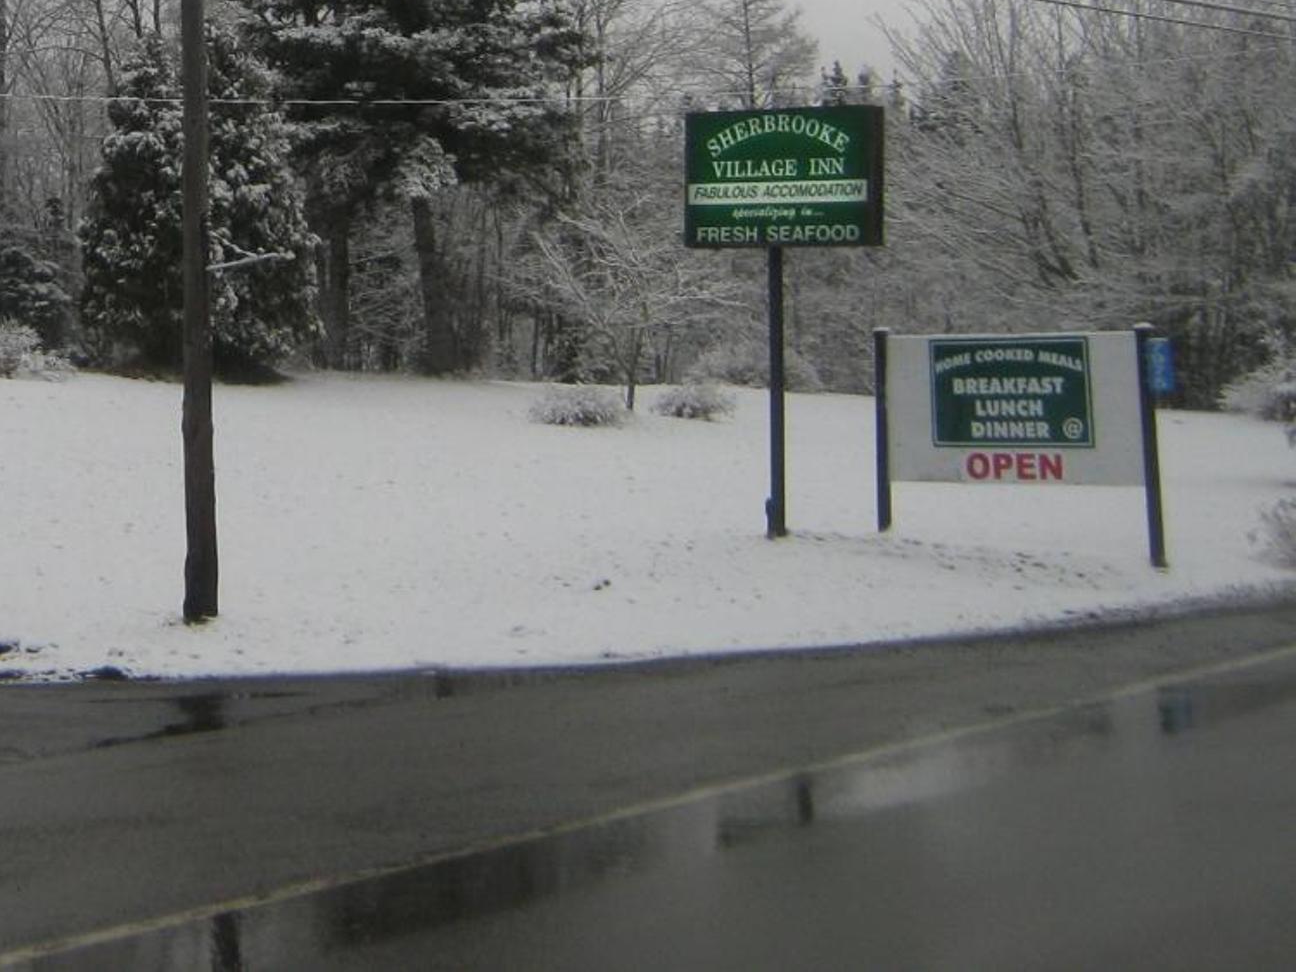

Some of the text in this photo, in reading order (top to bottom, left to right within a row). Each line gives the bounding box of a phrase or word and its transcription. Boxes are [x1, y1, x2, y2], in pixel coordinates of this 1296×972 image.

[707, 114, 850, 158] SHERBROOKE
[712, 158, 845, 178] VILLAGE INN
[694, 182, 863, 200] FABULOUS ACCOMODATION
[696, 225, 860, 243] FRESH SEAFOOD
[935, 349, 1083, 373] HOME COOKED MEALS
[953, 377, 1064, 395] BREAKFAST
[975, 399, 1044, 417] LUNCH
[971, 421, 1050, 439] DINNER
[966, 453, 1063, 480] OPEN
